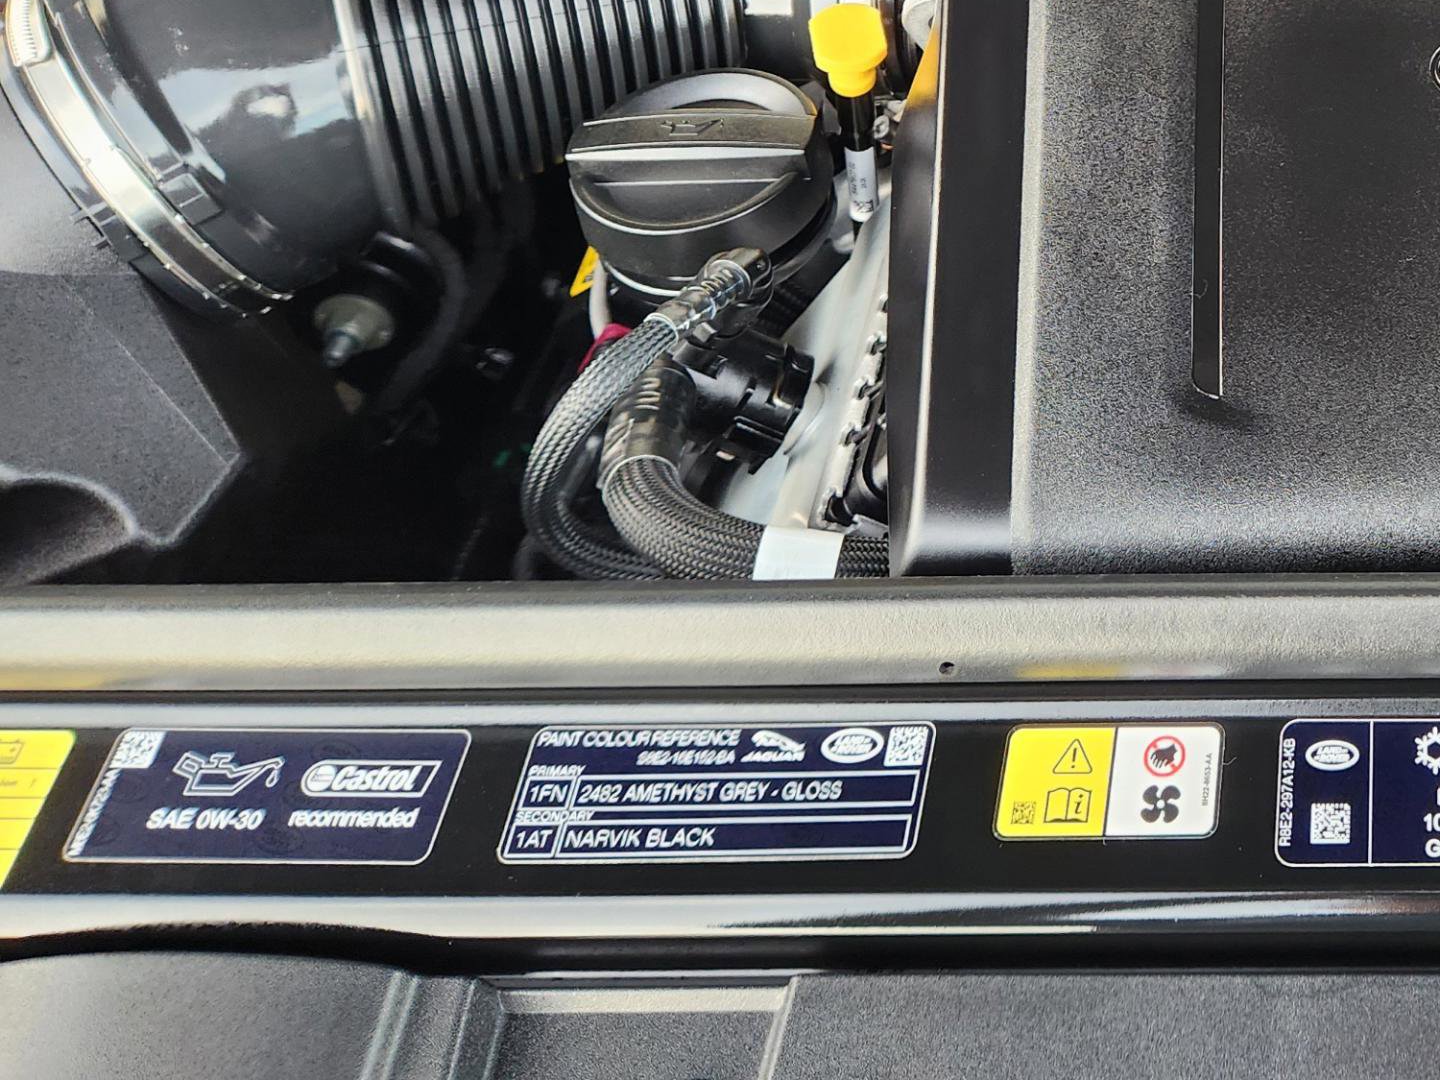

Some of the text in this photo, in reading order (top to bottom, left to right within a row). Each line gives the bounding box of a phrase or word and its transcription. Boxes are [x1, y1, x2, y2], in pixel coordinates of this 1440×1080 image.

[536, 728, 743, 748] PAINT COLOUR REFERENCE
[740, 749, 807, 763] JAGUAR
[331, 764, 422, 792] Castrol
[527, 764, 586, 777] PRIMARY
[529, 784, 568, 804] 1FN
[577, 783, 624, 804] 2482
[622, 781, 720, 804] AMETHYST
[719, 780, 773, 803] GREY
[781, 779, 843, 802] GLOSS
[146, 806, 267, 830] SAE 0W-30
[288, 806, 420, 828] recommended
[515, 810, 597, 822] SECONDARY
[516, 827, 717, 850] 1AT NARVIK BLACK
